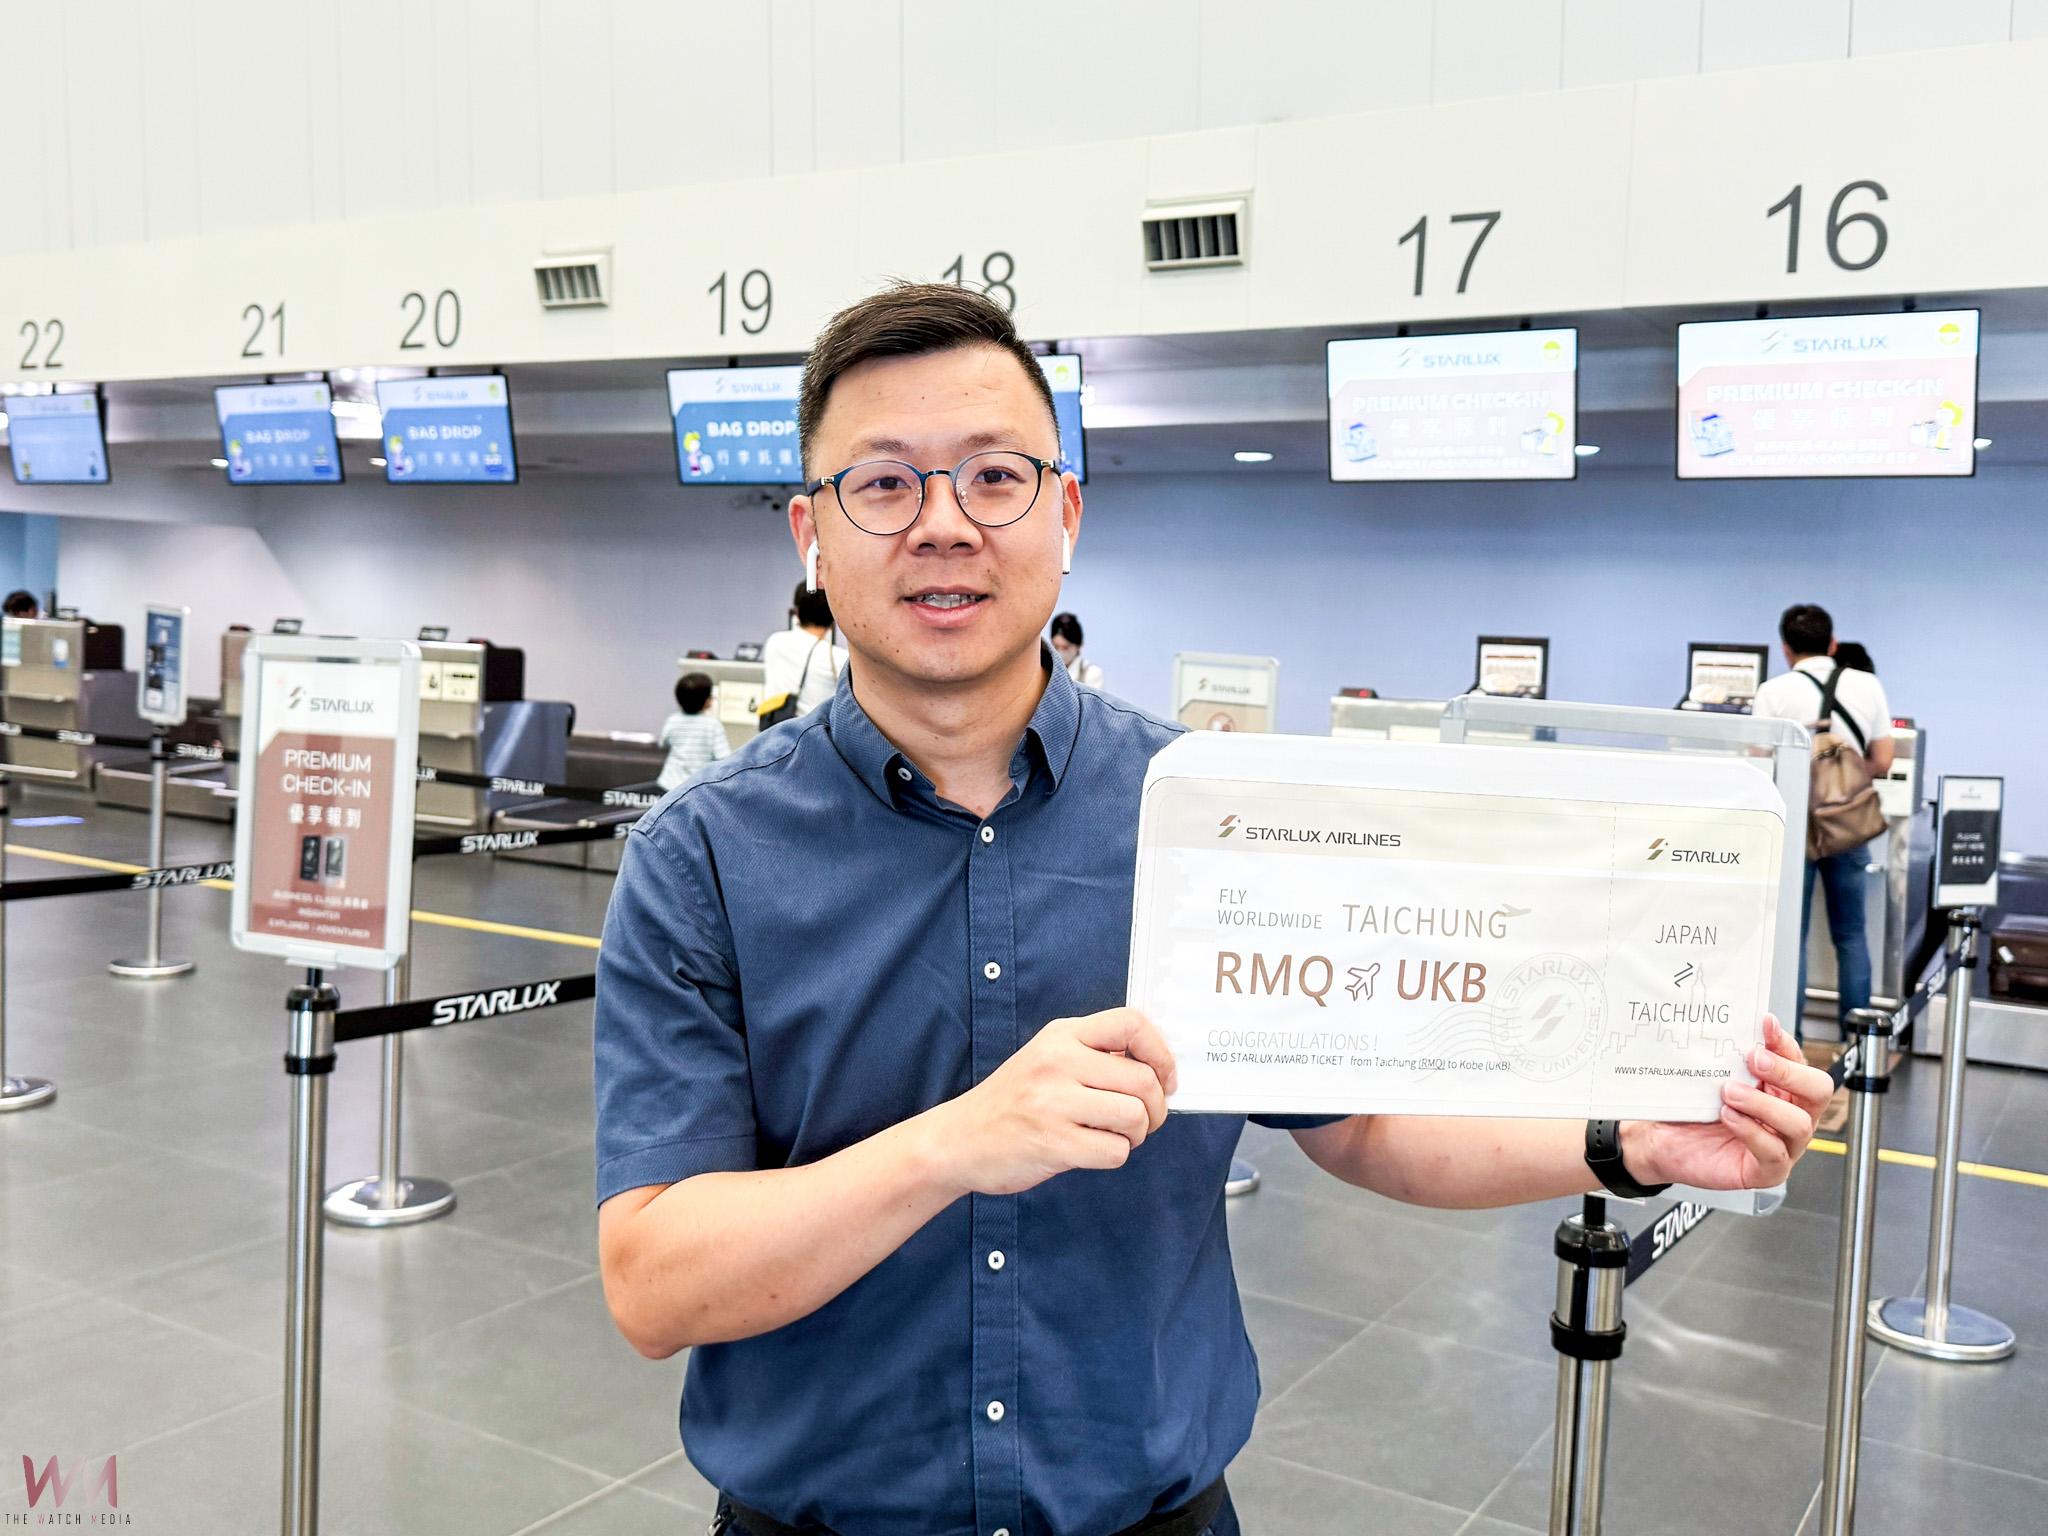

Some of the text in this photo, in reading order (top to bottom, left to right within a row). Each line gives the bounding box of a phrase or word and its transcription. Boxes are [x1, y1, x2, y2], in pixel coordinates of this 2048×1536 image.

[1766, 180, 1889, 274] 16
[1397, 211, 1502, 296] 17
[707, 269, 773, 336] 19
[241, 301, 286, 357] 21
[399, 290, 461, 349] 20
[20, 319, 64, 369] 22
[1793, 335, 1887, 352] STARLUX
[1423, 352, 1501, 368] STARLUX
[1707, 383, 1823, 403] PREMIUM
[407, 424, 482, 440] BAG DROP
[706, 420, 797, 437] BAG DROP
[310, 697, 375, 713] STARLUX
[284, 749, 371, 773] PREMIUM
[282, 773, 371, 799] CHECK-IN
[490, 777, 545, 797] STARLUX
[460, 830, 539, 854] STARLUX
[1246, 827, 1401, 847] STARLUX AIRLINES
[1671, 849, 1740, 864] STARLUX
[1219, 888, 1247, 905] FLY
[1217, 904, 1508, 939] WORLDWIDE TAICHUNG
[1655, 924, 1718, 945] JAPAN
[1215, 951, 1488, 1007] RMQ UKB
[1502, 959, 1596, 1003] STARLUX
[430, 981, 562, 1026] STARLUX
[1628, 1001, 1730, 1024] TAICHUNG
[1208, 1030, 1369, 1051] CONGRATULATIONS
[1543, 1007, 1601, 1074] UNIVERSE
[1206, 1052, 1228, 1063] TWO
[1230, 1053, 1272, 1064] STARLUX
[1274, 1054, 1309, 1065] AWARD
[1312, 1055, 1344, 1066] TICKET
[1350, 1056, 1372, 1067] from
[1375, 1057, 1416, 1070] Taichung
[1418, 1058, 1446, 1071] (RMQ)
[1448, 1060, 1458, 1069] to
[1460, 1060, 1483, 1071] Kobe
[1614, 1066, 1731, 1078] WWW.STARLUX-AIRLINES.COM
